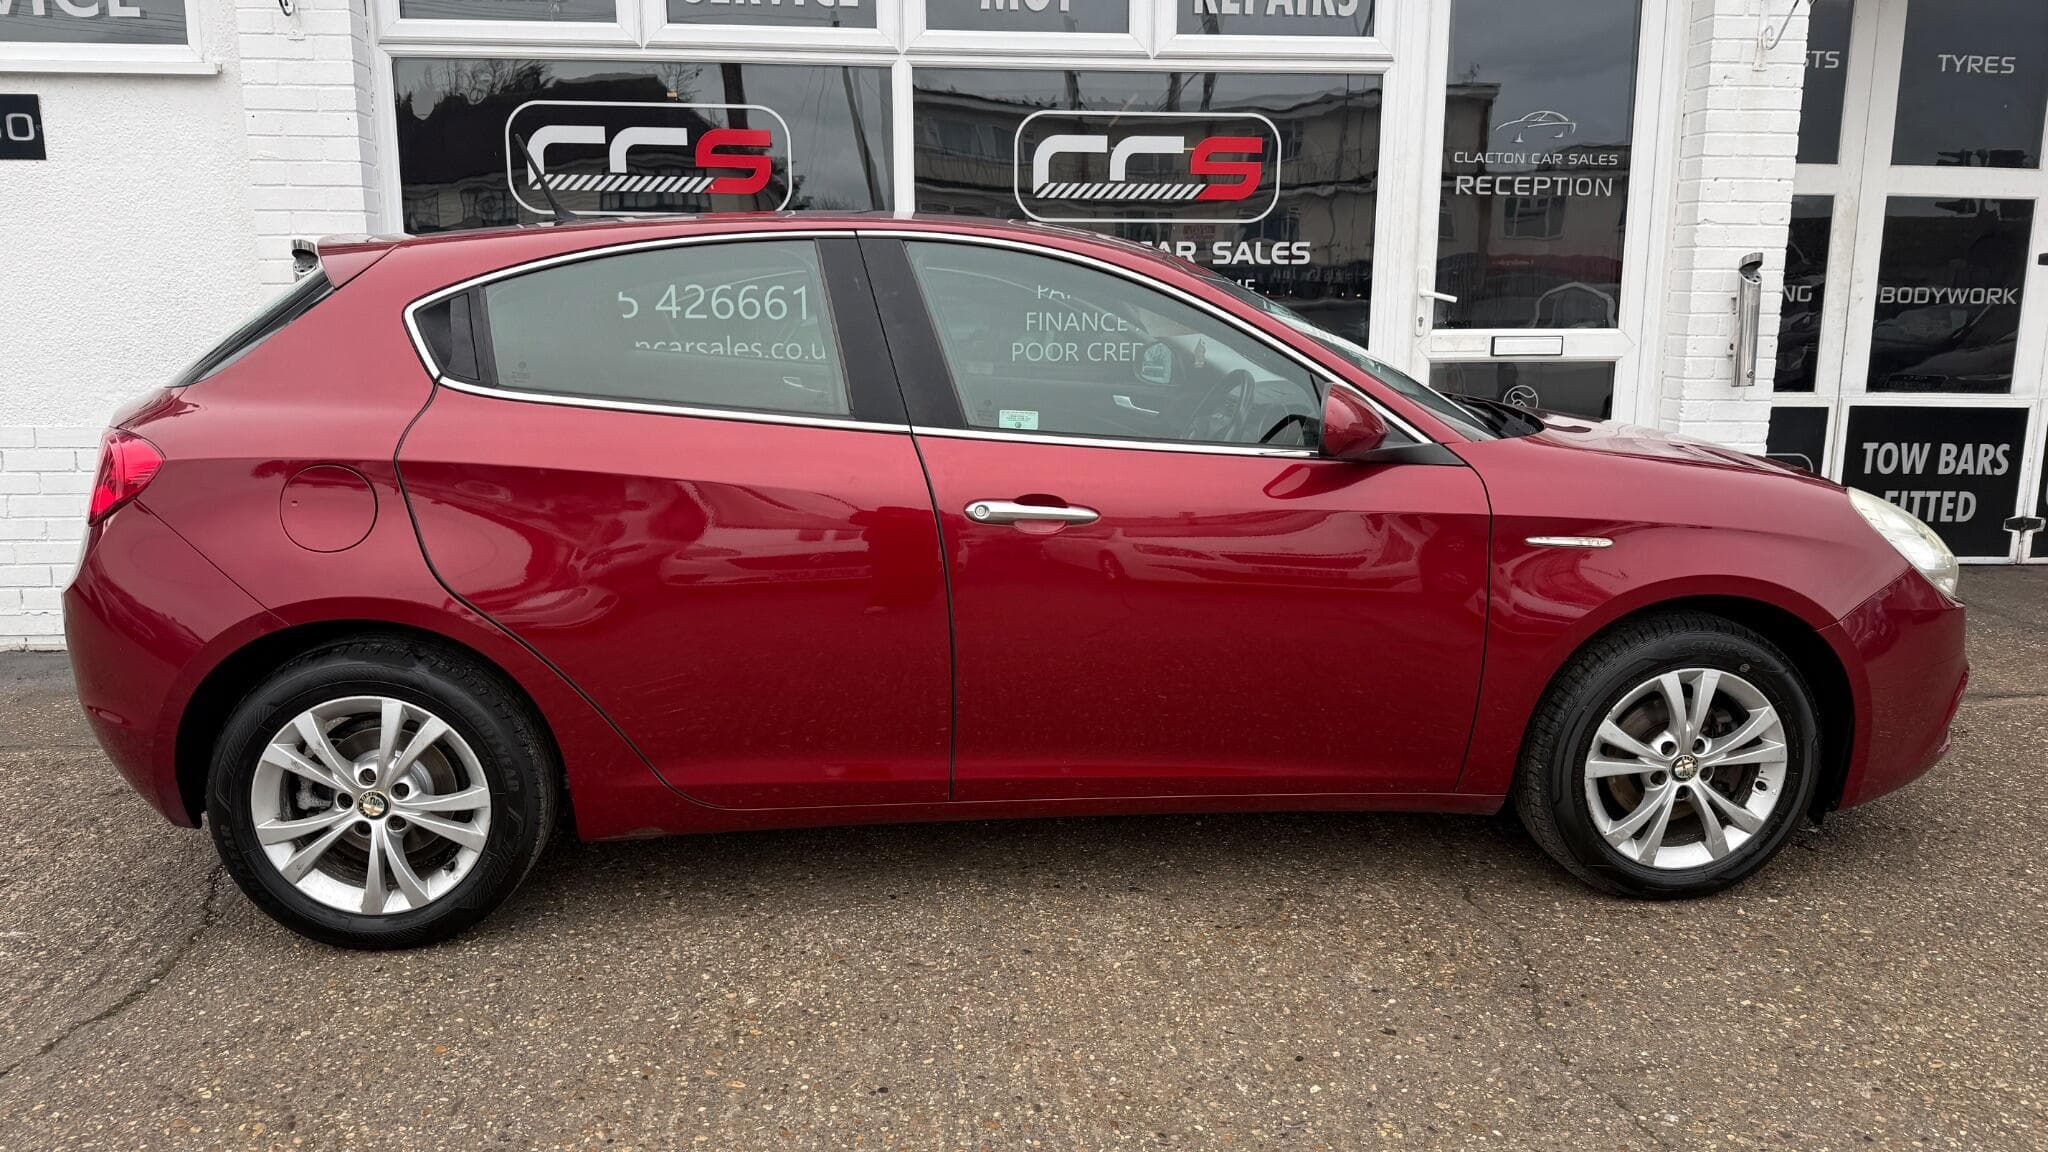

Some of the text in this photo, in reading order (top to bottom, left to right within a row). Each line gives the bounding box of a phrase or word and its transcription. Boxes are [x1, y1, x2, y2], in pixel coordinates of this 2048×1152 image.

[1937, 54, 2016, 74] TYRES
[0, 112, 35, 141] 0
[1454, 151, 1619, 166] CLACTON CAR SALES
[1455, 175, 1613, 197] RECEPTION
[1212, 241, 1311, 265] SALES
[655, 284, 807, 320] 426661
[1879, 286, 2019, 305] BODYWORK
[1026, 311, 1128, 332] FINANCE
[1012, 342, 1079, 362] POOR
[1862, 442, 2011, 476] TOW BARS
[1884, 490, 1977, 523] FITTED
